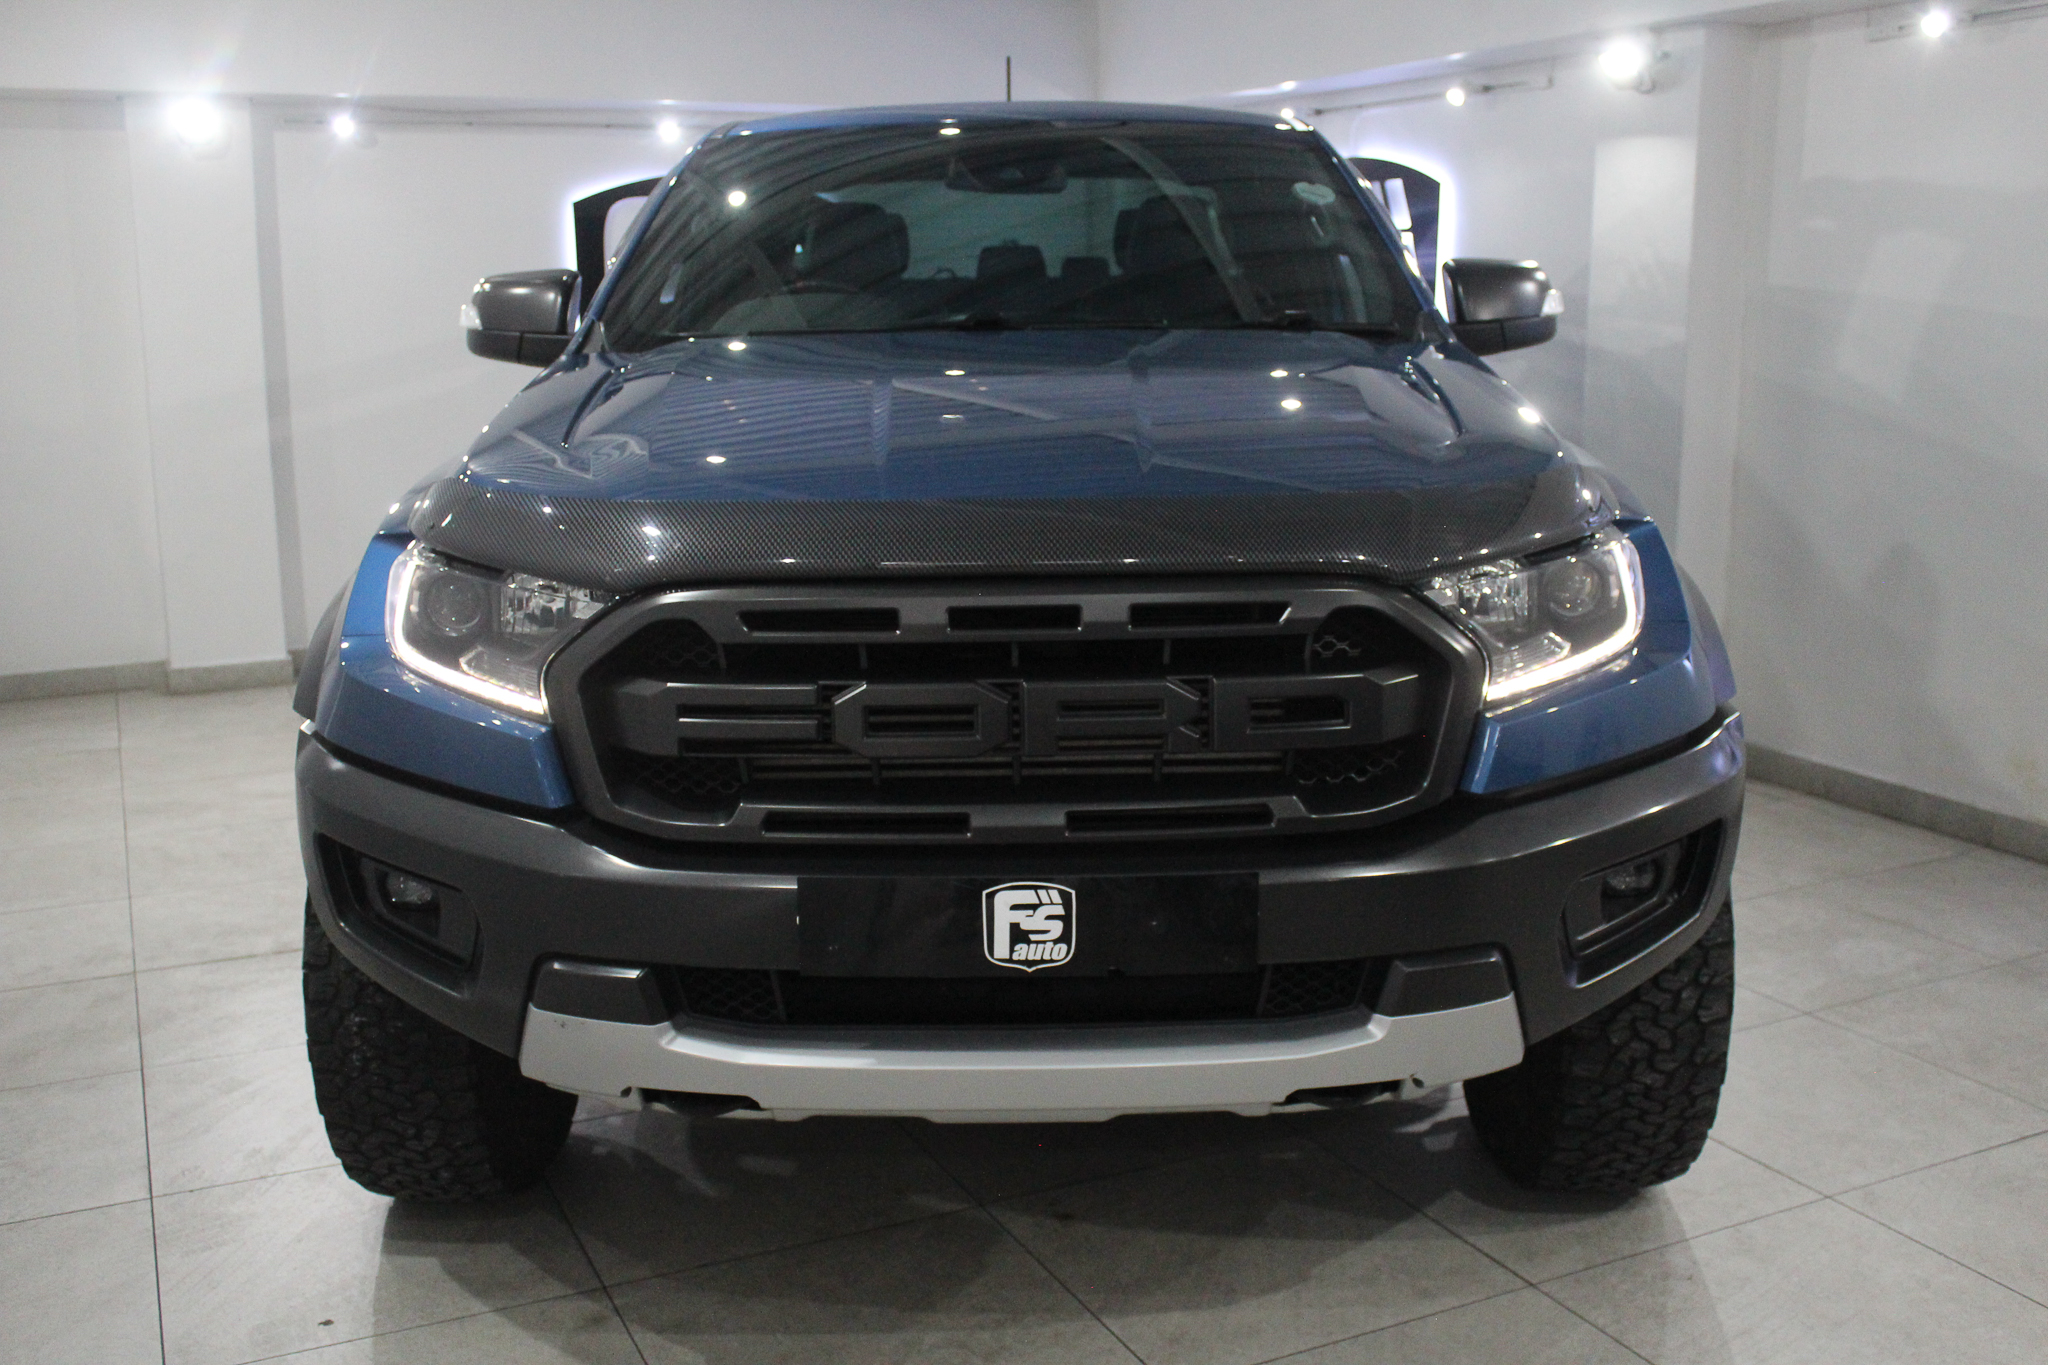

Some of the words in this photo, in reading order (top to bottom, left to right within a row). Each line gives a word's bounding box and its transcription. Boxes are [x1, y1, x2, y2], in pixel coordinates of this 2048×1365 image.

[613, 674, 1421, 758] FORD
[993, 889, 1066, 960] FS
[1012, 941, 1068, 961] auto
